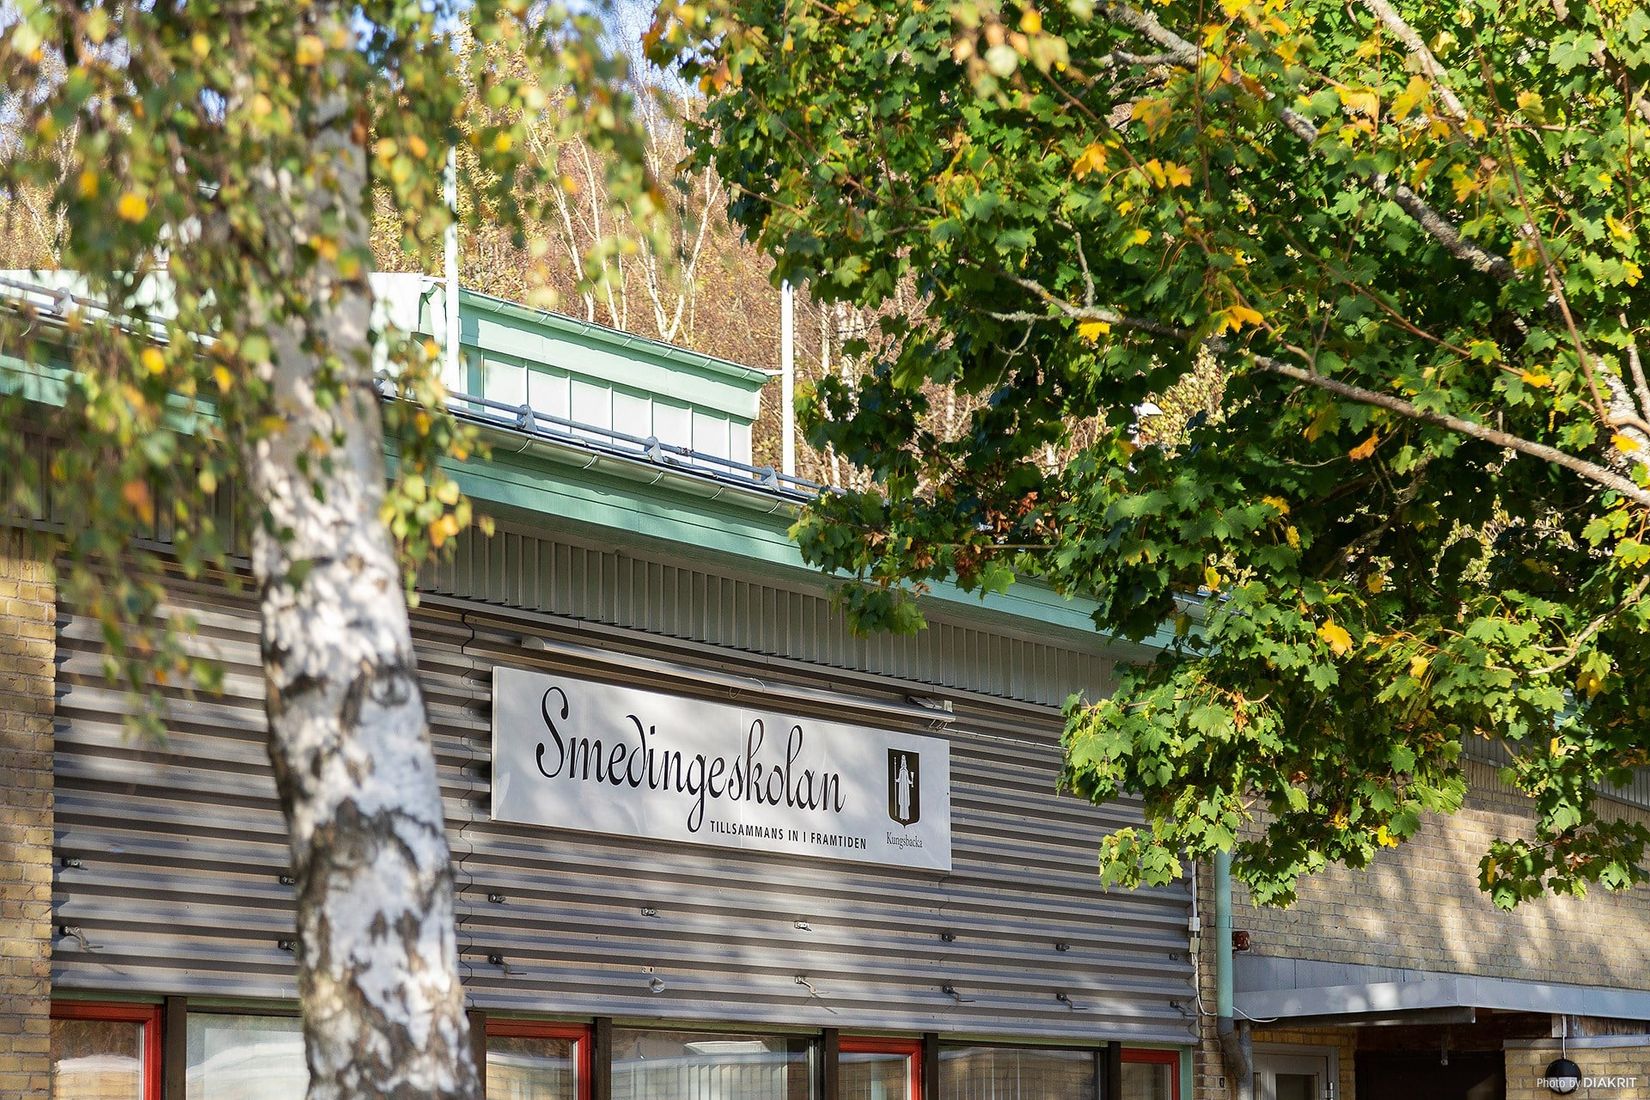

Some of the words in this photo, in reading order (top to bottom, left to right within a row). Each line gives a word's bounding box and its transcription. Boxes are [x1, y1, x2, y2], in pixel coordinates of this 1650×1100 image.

[535, 686, 846, 833] Smedingeskolan
[710, 820, 784, 840] TILLSAMMANS
[788, 832, 799, 842] IN
[810, 834, 867, 850] FRAMTIDEN
[886, 831, 923, 849] Kungsbacka
